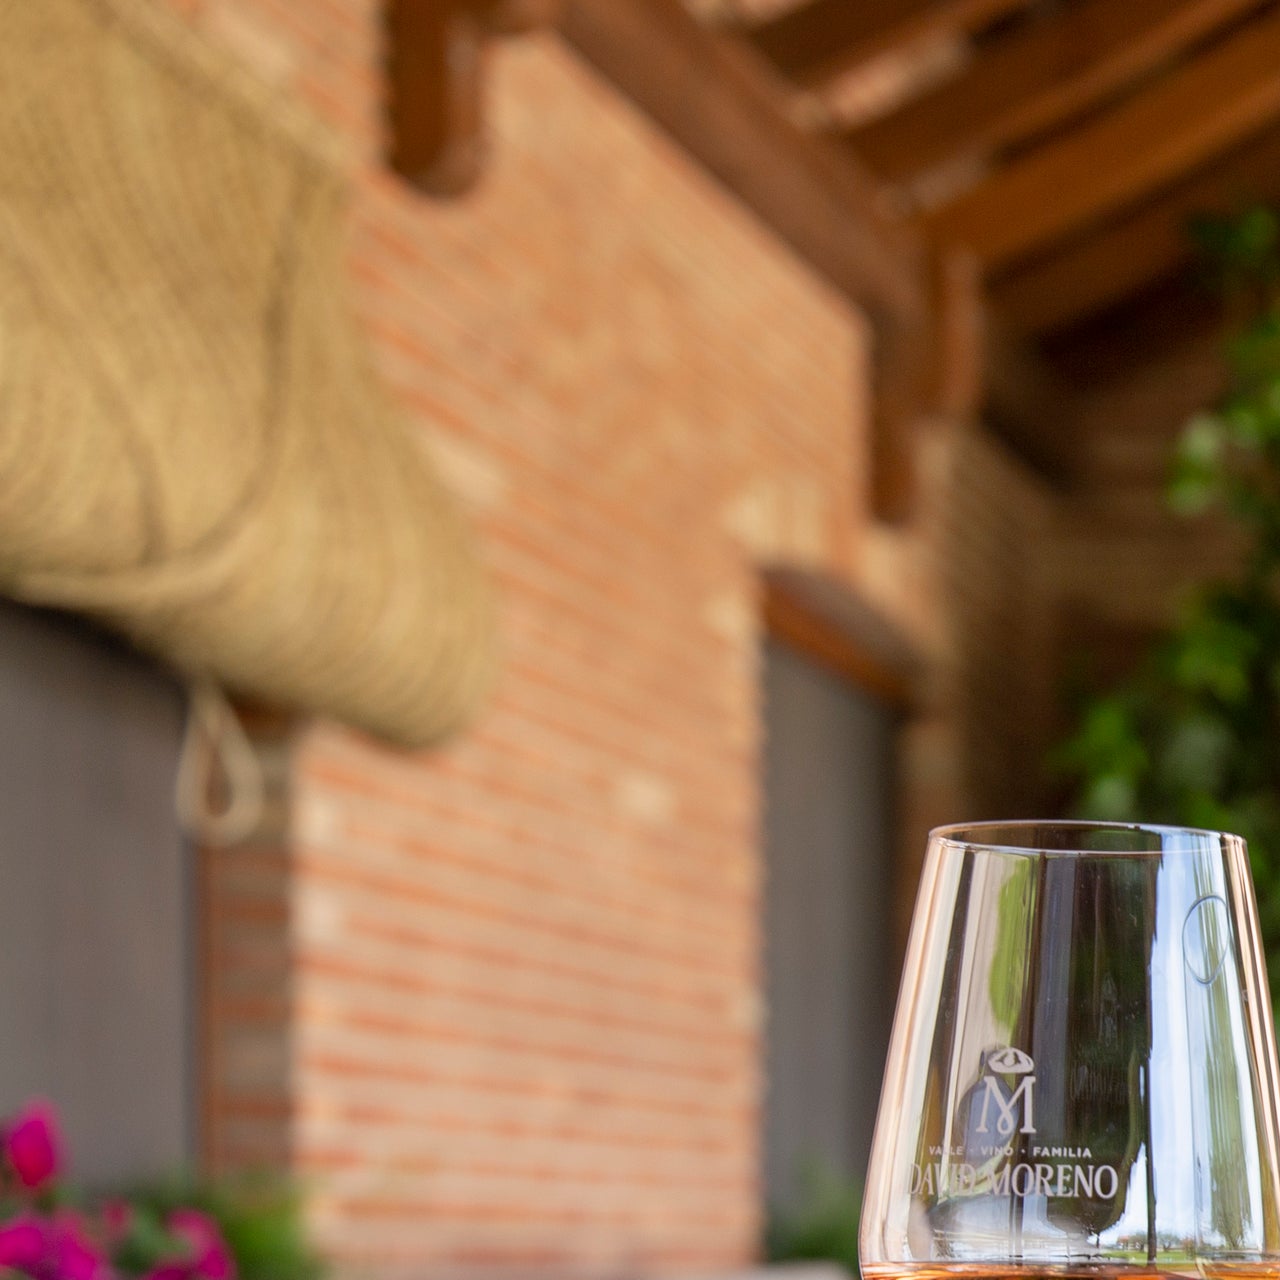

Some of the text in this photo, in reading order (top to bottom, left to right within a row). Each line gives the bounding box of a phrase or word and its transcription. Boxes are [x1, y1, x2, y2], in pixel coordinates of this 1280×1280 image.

[976, 1076, 1036, 1133] M
[929, 1146, 1092, 1158] VALLE VINO FAMILIA
[908, 1163, 1118, 1199] DAVID MORENO
